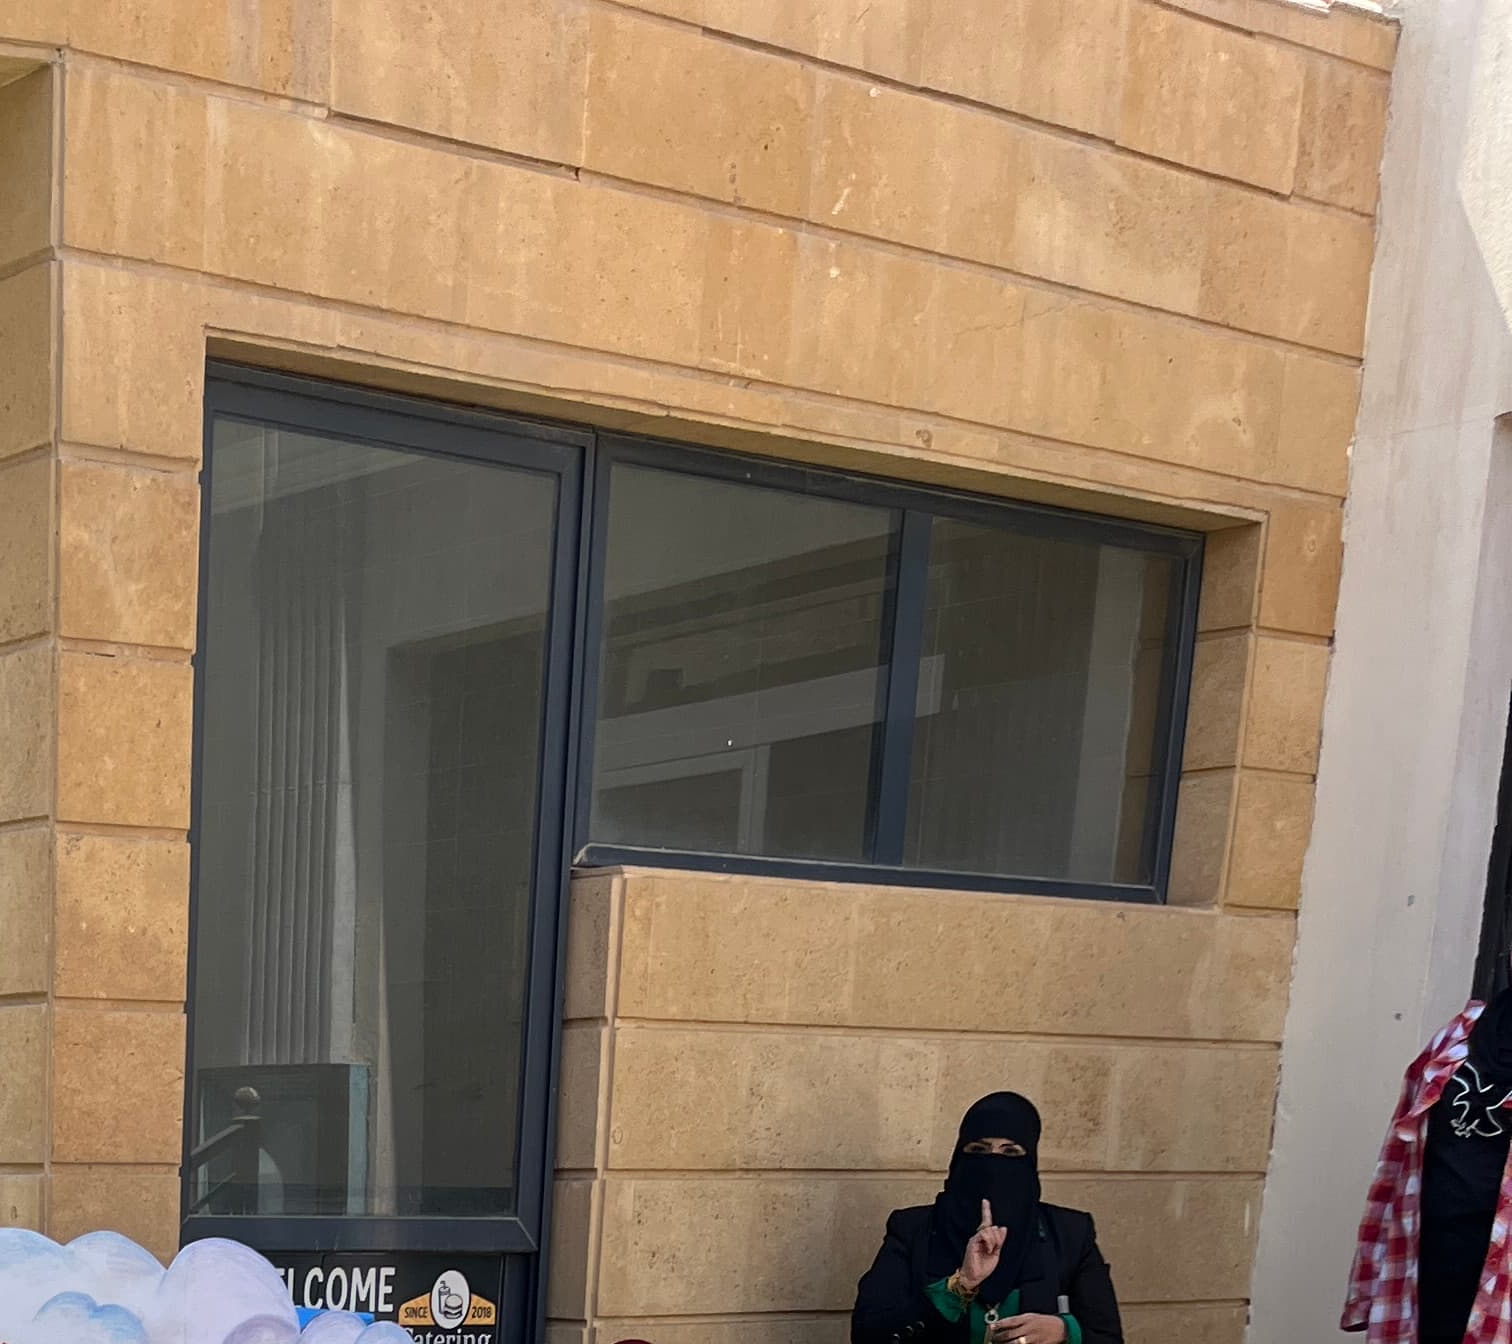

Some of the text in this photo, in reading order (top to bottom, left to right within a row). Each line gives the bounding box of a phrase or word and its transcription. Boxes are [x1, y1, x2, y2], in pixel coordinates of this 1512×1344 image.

[276, 1267, 395, 1312] LCOME
[404, 1307, 492, 1319] SINCE 2018
